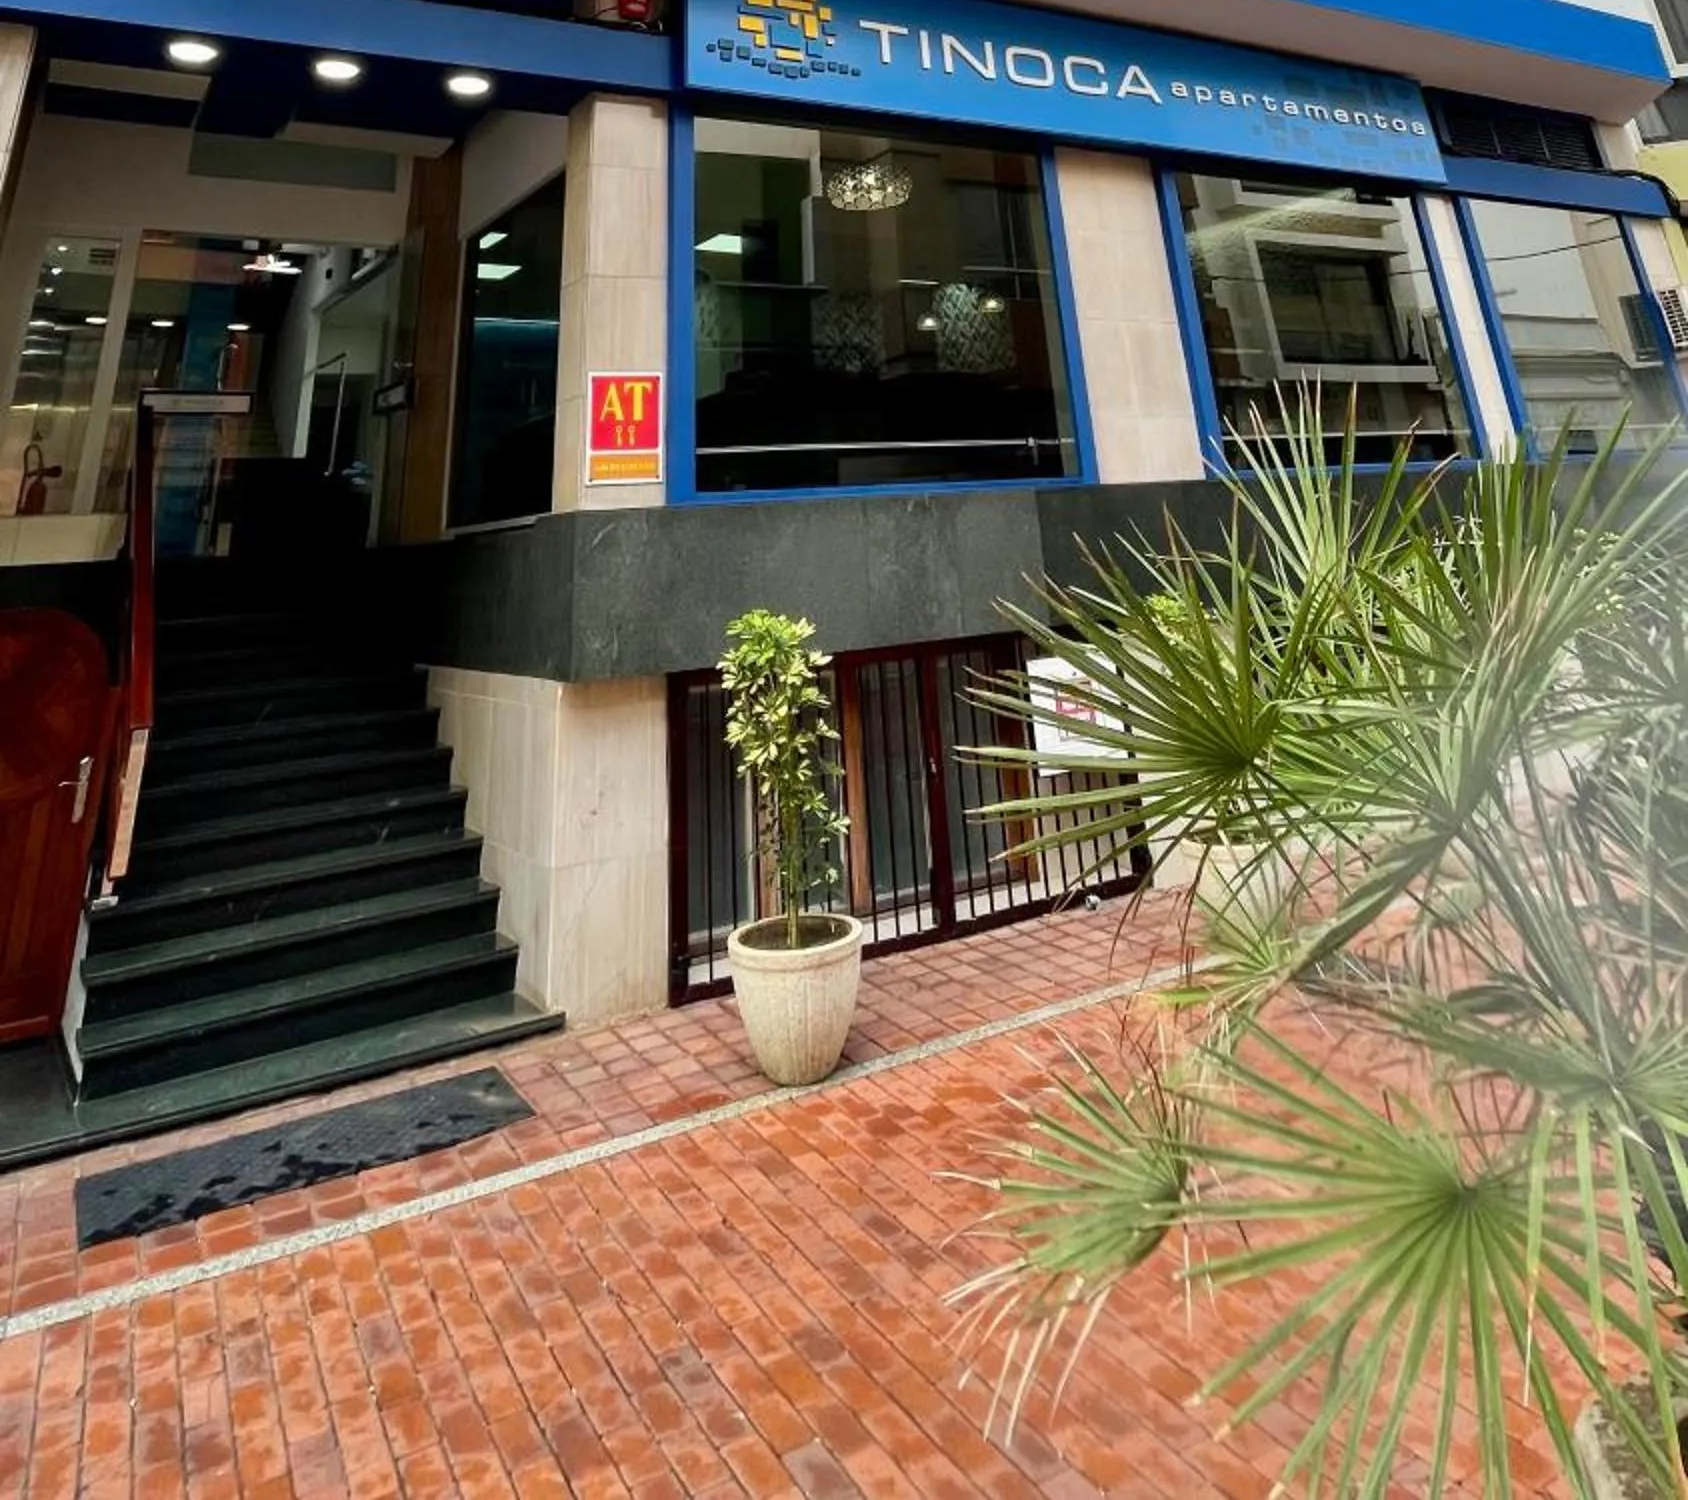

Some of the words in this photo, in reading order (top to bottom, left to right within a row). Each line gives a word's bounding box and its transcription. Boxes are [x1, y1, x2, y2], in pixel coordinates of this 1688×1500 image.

[859, 19, 1163, 105] TINOCA
[1170, 80, 1426, 136] apartamentos
[599, 381, 653, 421] AT
